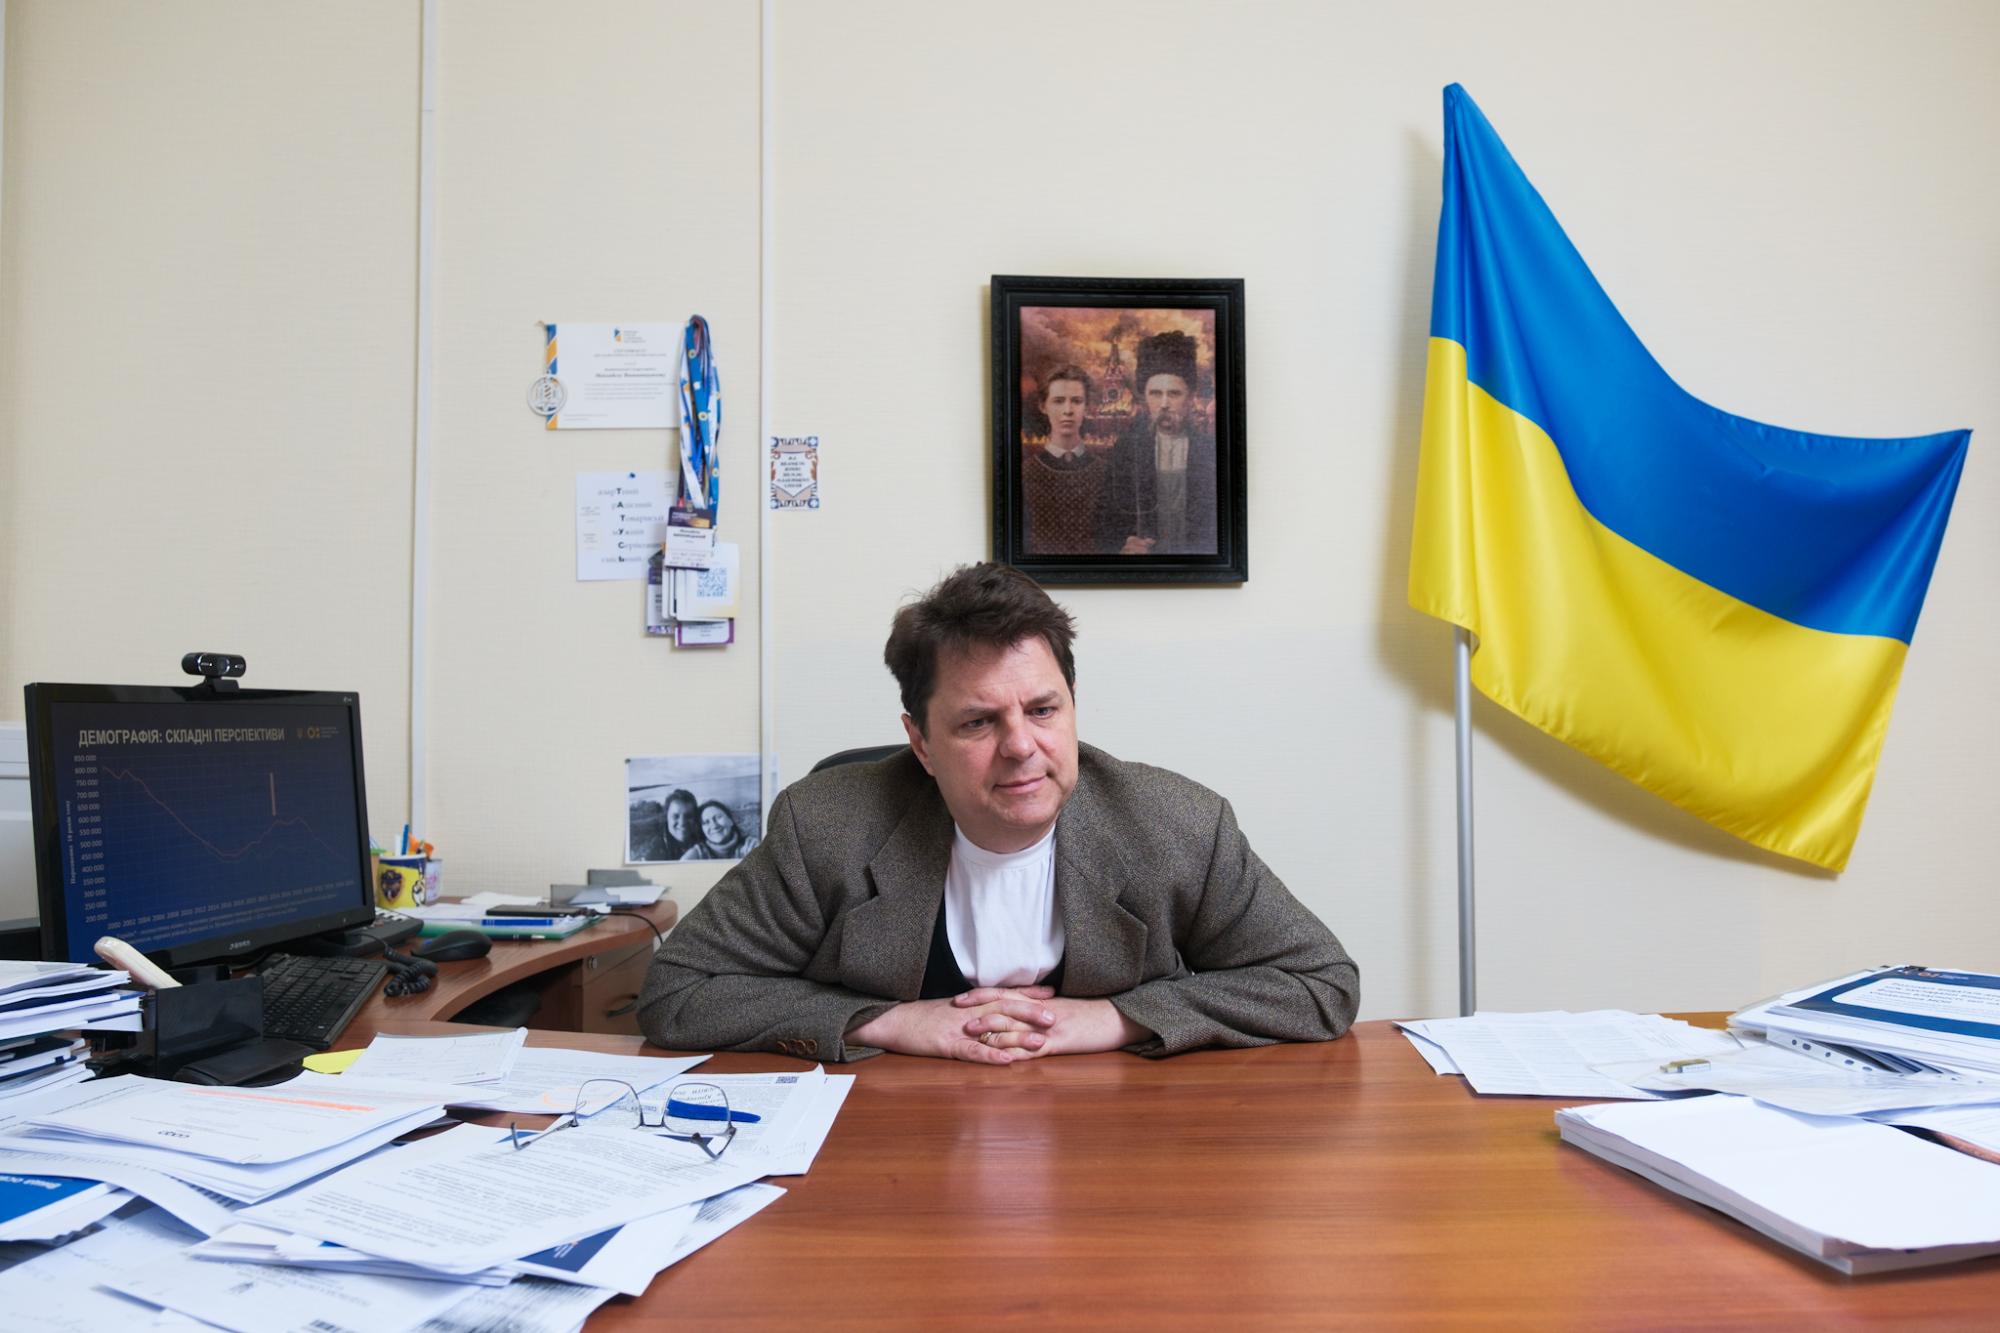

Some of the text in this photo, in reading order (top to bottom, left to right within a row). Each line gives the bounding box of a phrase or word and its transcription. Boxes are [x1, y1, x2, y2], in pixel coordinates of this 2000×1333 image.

[79, 728, 285, 747] ДЕМОГРАФІЯ: СКЛАДНІ ПЕРСПЕКТИВИ
